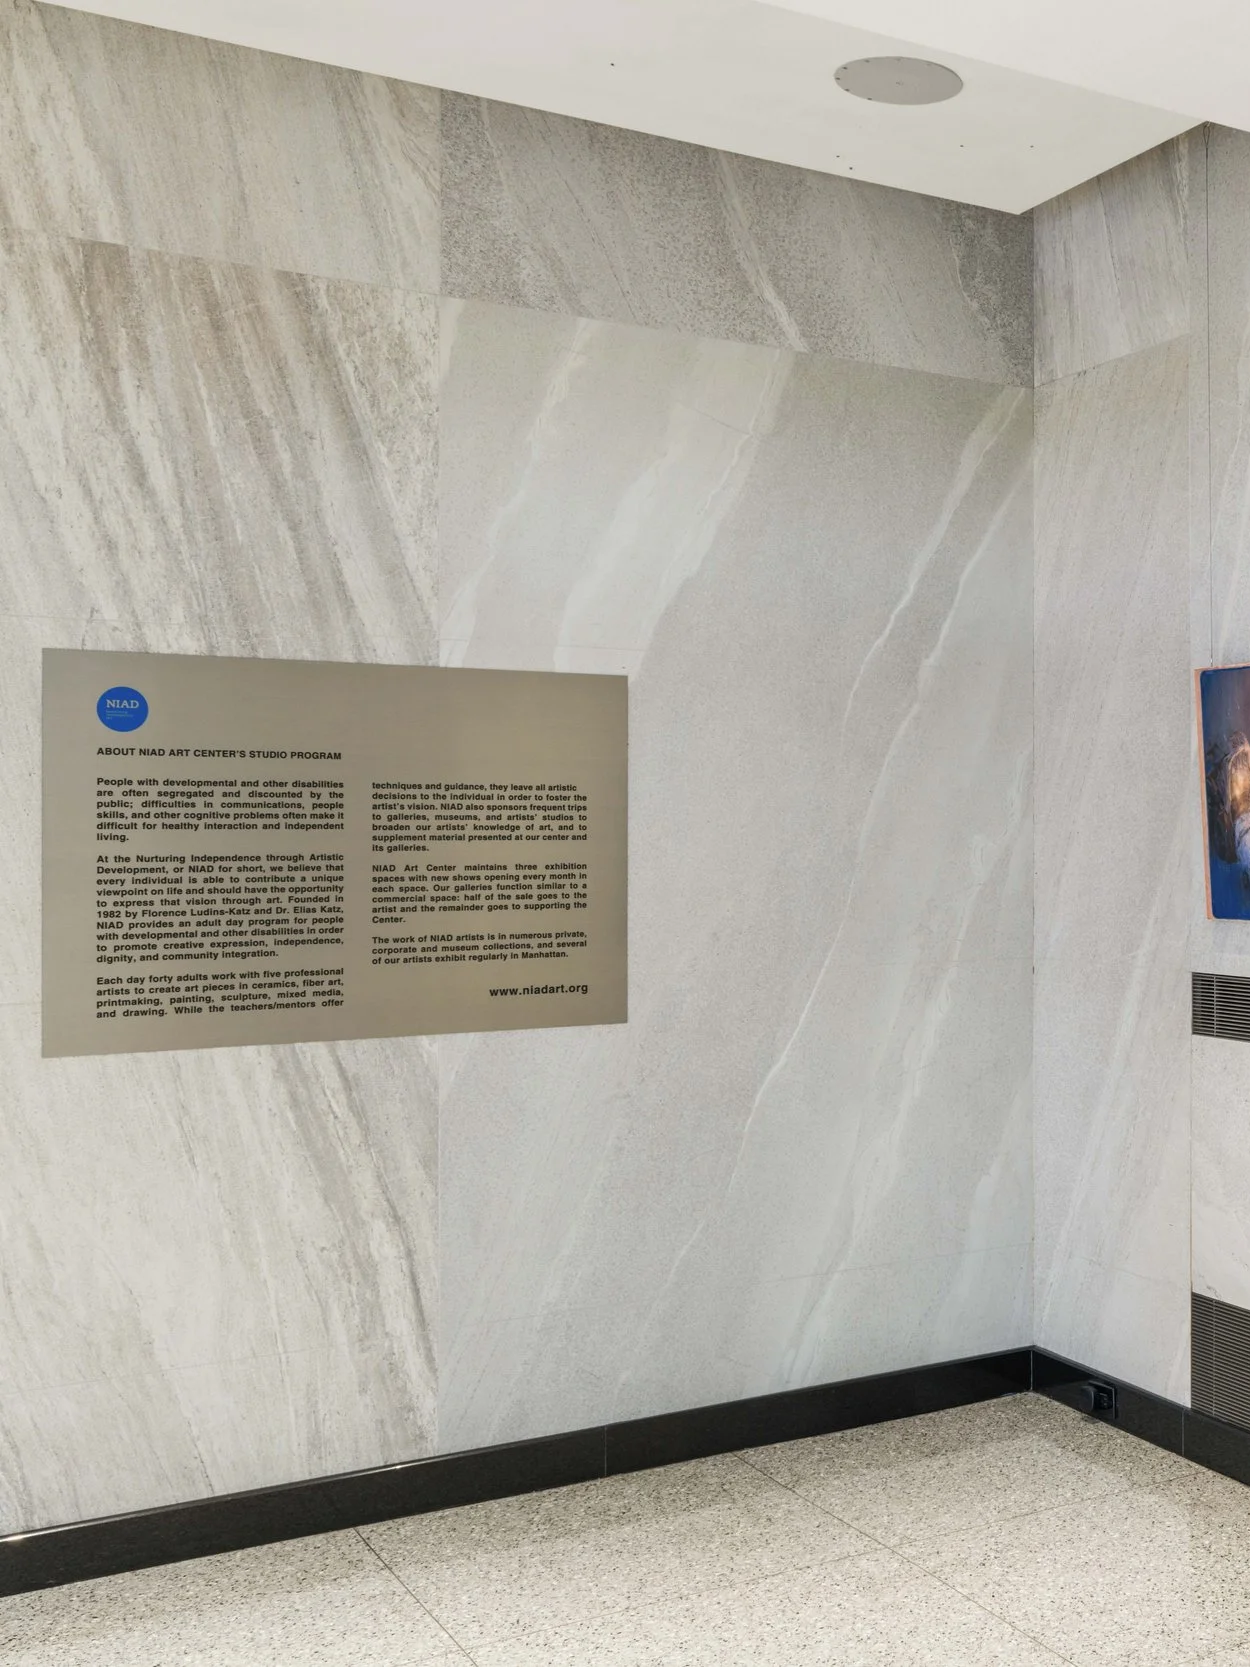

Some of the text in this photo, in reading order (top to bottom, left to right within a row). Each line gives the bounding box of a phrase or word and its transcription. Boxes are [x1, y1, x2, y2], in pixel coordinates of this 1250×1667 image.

[106, 699, 140, 709] NIAD
[96, 748, 136, 756] ABOUT
[139, 749, 166, 757] NIAD
[168, 749, 191, 757] ART
[249, 750, 288, 758] STUDIO
[290, 751, 342, 759] PROGRAM
[97, 777, 344, 789] People with developmental and other disabilities
[372, 781, 577, 792] techniques and guidance, they leave all artistic
[121, 789, 149, 797] often
[157, 789, 214, 799] segregated
[221, 789, 241, 798] and
[248, 789, 303, 798] discounted
[310, 790, 322, 800] by
[328, 790, 344, 798] the
[372, 791, 587, 801] decisions to the individual in order to foster the
[96, 799, 344, 811] public; difficulties in communications, people
[407, 802, 438, 810] vision.
[440, 802, 464, 811] NIAD
[465, 802, 485, 811] also
[486, 804, 528, 813] sponsors
[529, 803, 566, 813] frequent
[567, 803, 587, 813] trips
[96, 810, 344, 821] skills, and other cognitive problems often make it
[372, 812, 382, 821] to
[386, 812, 430, 822] galleries,
[434, 814, 481, 822] museums,
[485, 812, 502, 821] and
[542, 813, 574, 821] studios
[578, 813, 588, 821] to
[96, 821, 344, 831] difficult for healthy interaction and independent
[372, 822, 411, 831] broaden
[473, 822, 521, 832] knowledge
[525, 822, 535, 831] of
[539, 822, 554, 832] art,
[558, 822, 574, 831] and
[578, 822, 588, 831] to
[97, 832, 129, 842] living.
[372, 833, 427, 843] supplement
[429, 833, 466, 841] material
[468, 832, 513, 843] presented
[514, 832, 523, 841] at
[542, 832, 570, 841] center
[571, 832, 587, 841] and
[372, 843, 430, 853] its galleries.
[372, 930, 587, 943] The work of NIAD artists is in numerous private,
[96, 936, 344, 952] to promote creative expression, independence,
[372, 939, 587, 956] corporate and museum collections, and several
[372, 956, 382, 964] of
[402, 954, 433, 963] artists
[434, 953, 466, 962] exhibit
[468, 951, 508, 963] regularly
[510, 951, 519, 960] in
[521, 949, 569, 959] Manhattan.
[96, 967, 344, 985] Each day forty adults work with five professional
[96, 978, 344, 995] artists to create art pieces in ceramics, fiber art,
[489, 985, 588, 998] www.niadart.org
[96, 988, 344, 1008] printmaking, painting, sculpture, mixed media,
[96, 998, 344, 1018] and drawing. While the teachers/mentors offer
